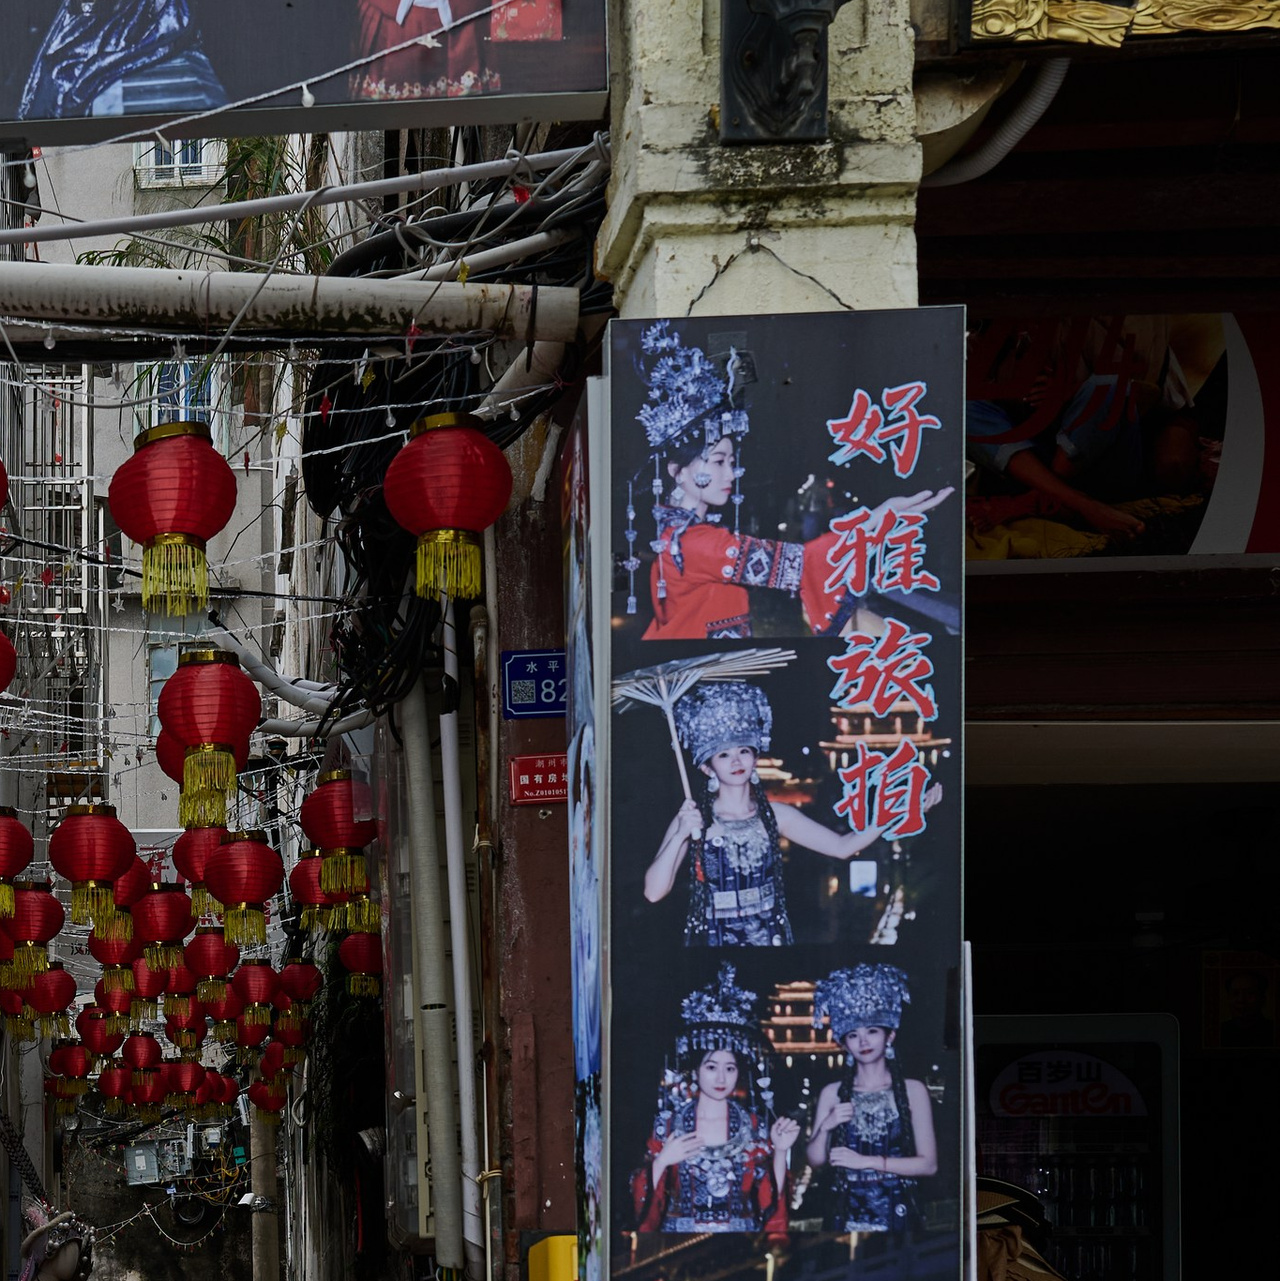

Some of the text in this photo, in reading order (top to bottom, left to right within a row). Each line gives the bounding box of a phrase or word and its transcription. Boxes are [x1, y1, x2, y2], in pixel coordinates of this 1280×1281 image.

[824, 380, 942, 841] 好雅旅拍
[1017, 1061, 1102, 1083] 百岁山
